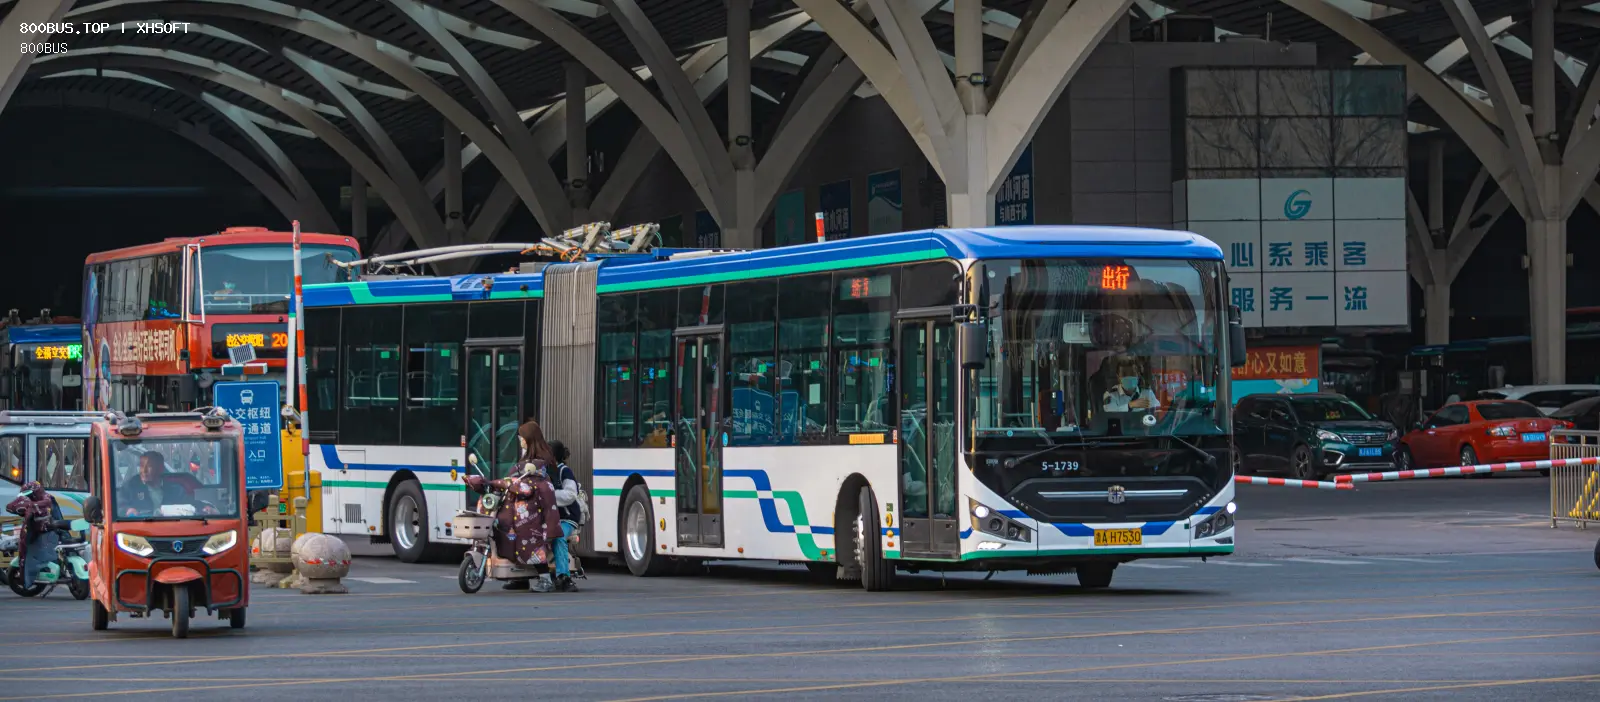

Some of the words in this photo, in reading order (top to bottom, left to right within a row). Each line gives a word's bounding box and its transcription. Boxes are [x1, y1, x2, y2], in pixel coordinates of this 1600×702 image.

[1230, 241, 1367, 267] 心系乘客
[1231, 286, 1368, 312] 服务一流
[248, 449, 266, 459] 入口
[1041, 461, 1079, 471] 5-1739
